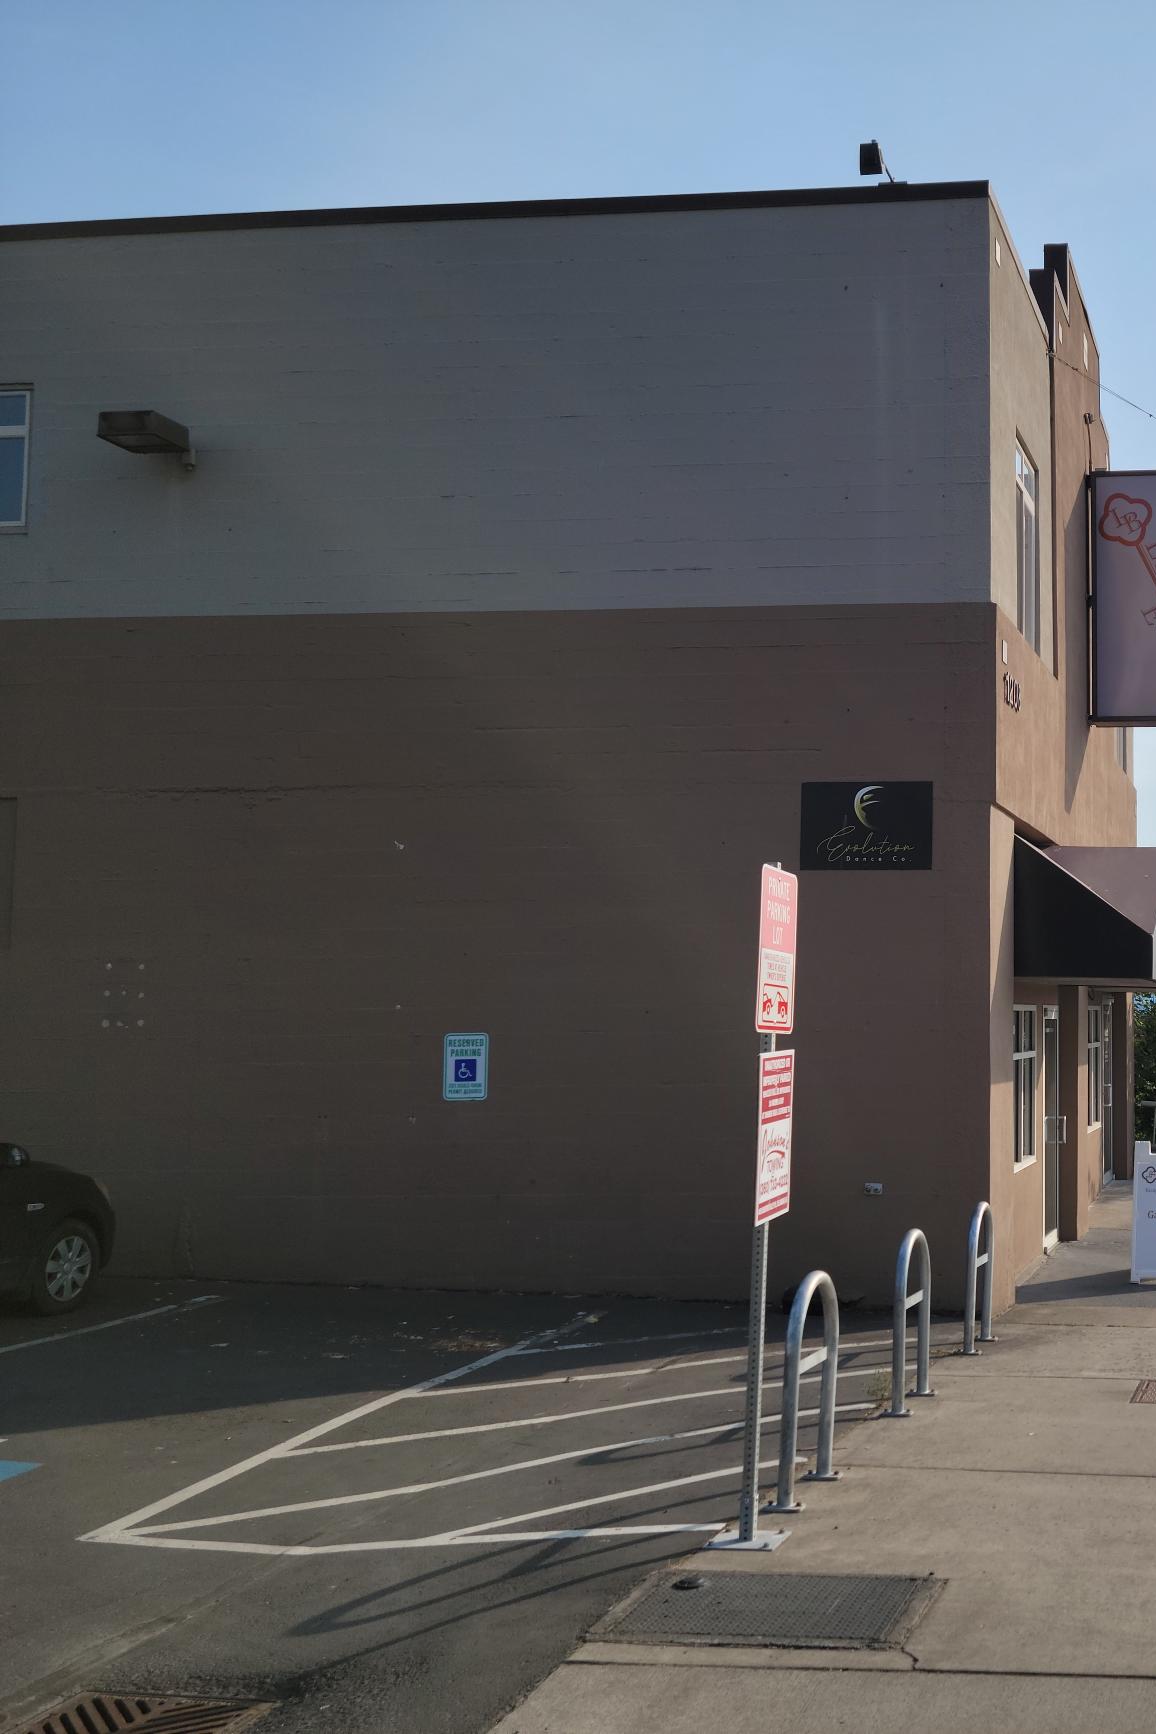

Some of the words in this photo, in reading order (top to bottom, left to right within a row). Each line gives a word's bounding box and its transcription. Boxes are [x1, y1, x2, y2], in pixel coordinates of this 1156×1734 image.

[816, 825, 914, 862] Evolution
[768, 876, 791, 901] PRIVATE
[767, 899, 791, 925] PARKING
[772, 927, 784, 945] LOT
[448, 1038, 484, 1048] RESERVED
[450, 1048, 481, 1057] PARKING
